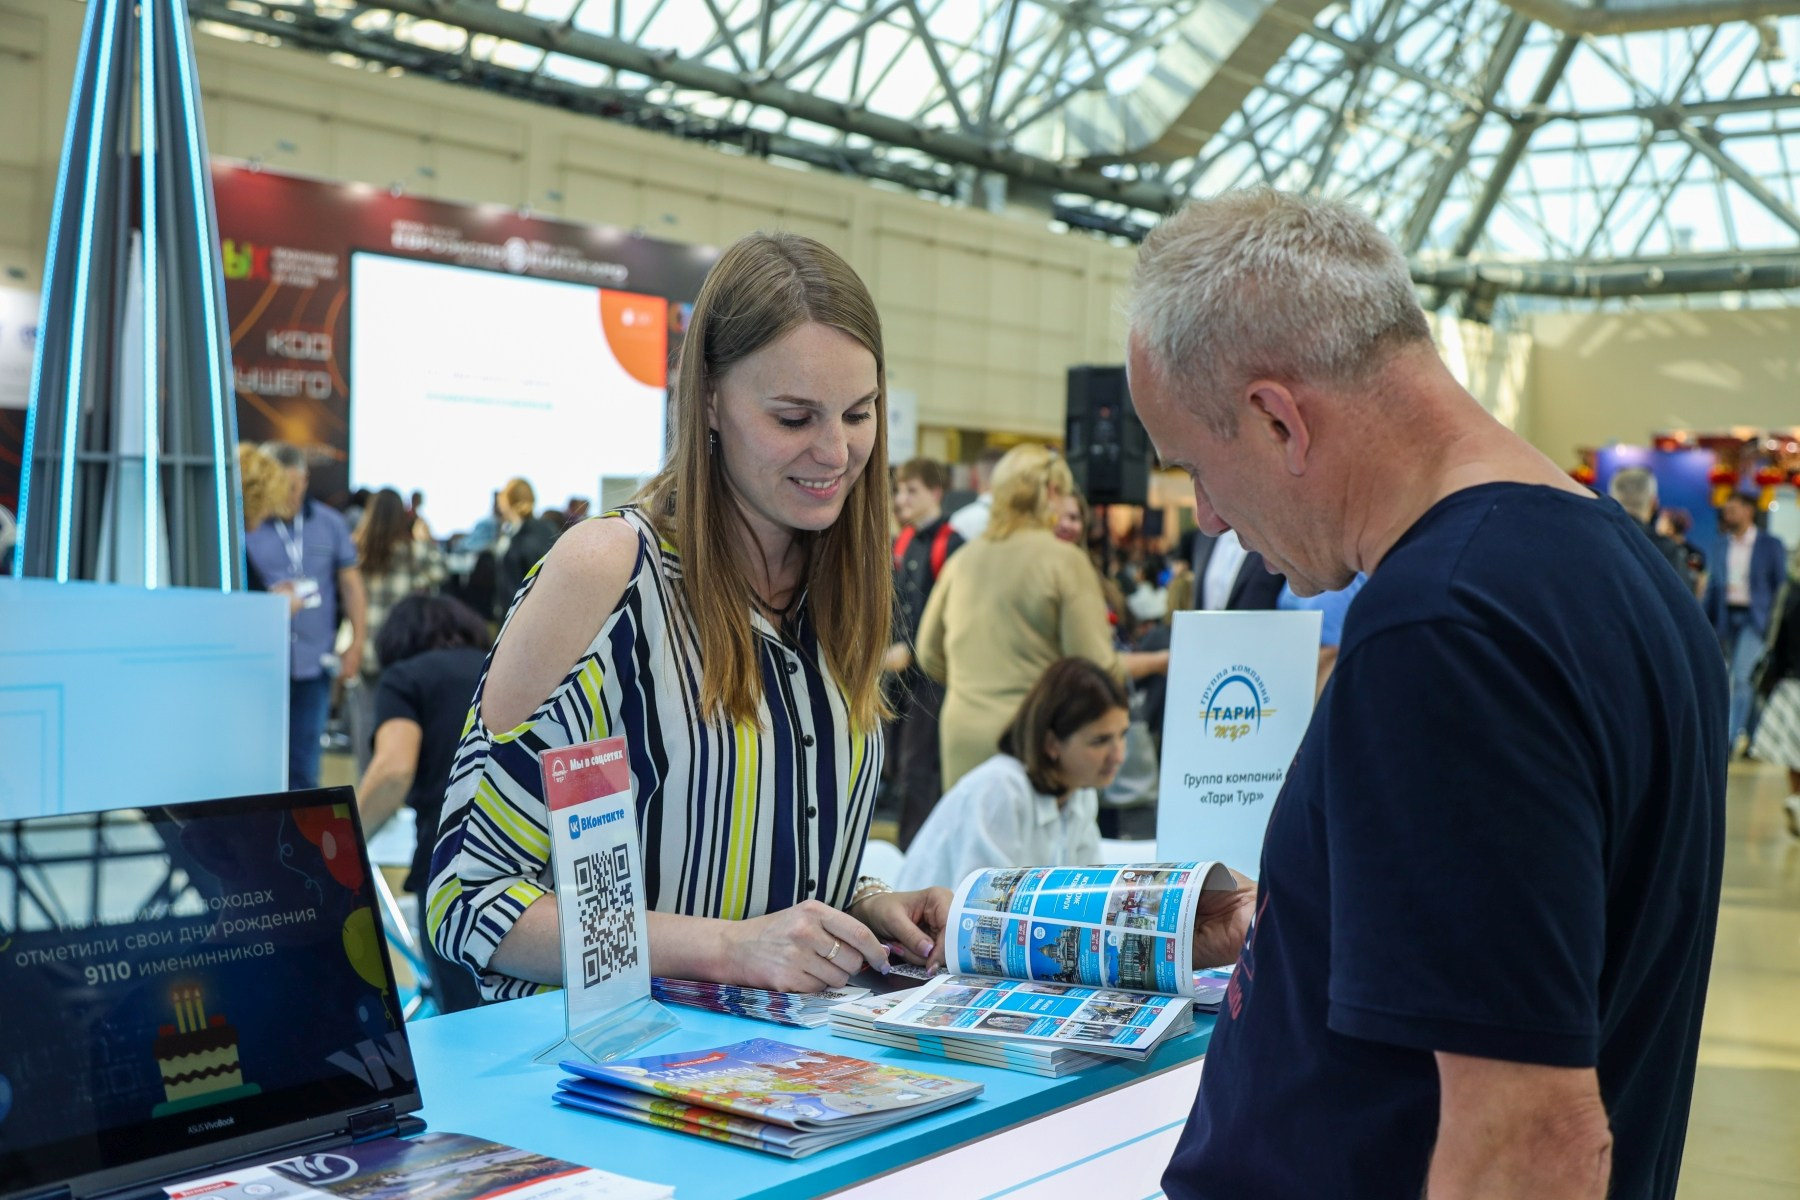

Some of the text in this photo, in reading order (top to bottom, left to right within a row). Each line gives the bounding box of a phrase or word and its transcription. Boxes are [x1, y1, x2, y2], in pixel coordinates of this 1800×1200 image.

[1200, 668, 1228, 705] группа
[1212, 706, 1256, 721] ТАРИ
[569, 758, 584, 772] Мы
[591, 750, 624, 766] соцсетях
[1184, 768, 1283, 789] Группа компаний
[1200, 790, 1264, 807] «Тари Тур»
[581, 808, 625, 831] ВКонтакте
[166, 889, 274, 917] телоходах
[16, 907, 317, 967] отметили свои дни рождения
[84, 941, 275, 986] 9110 именинников
